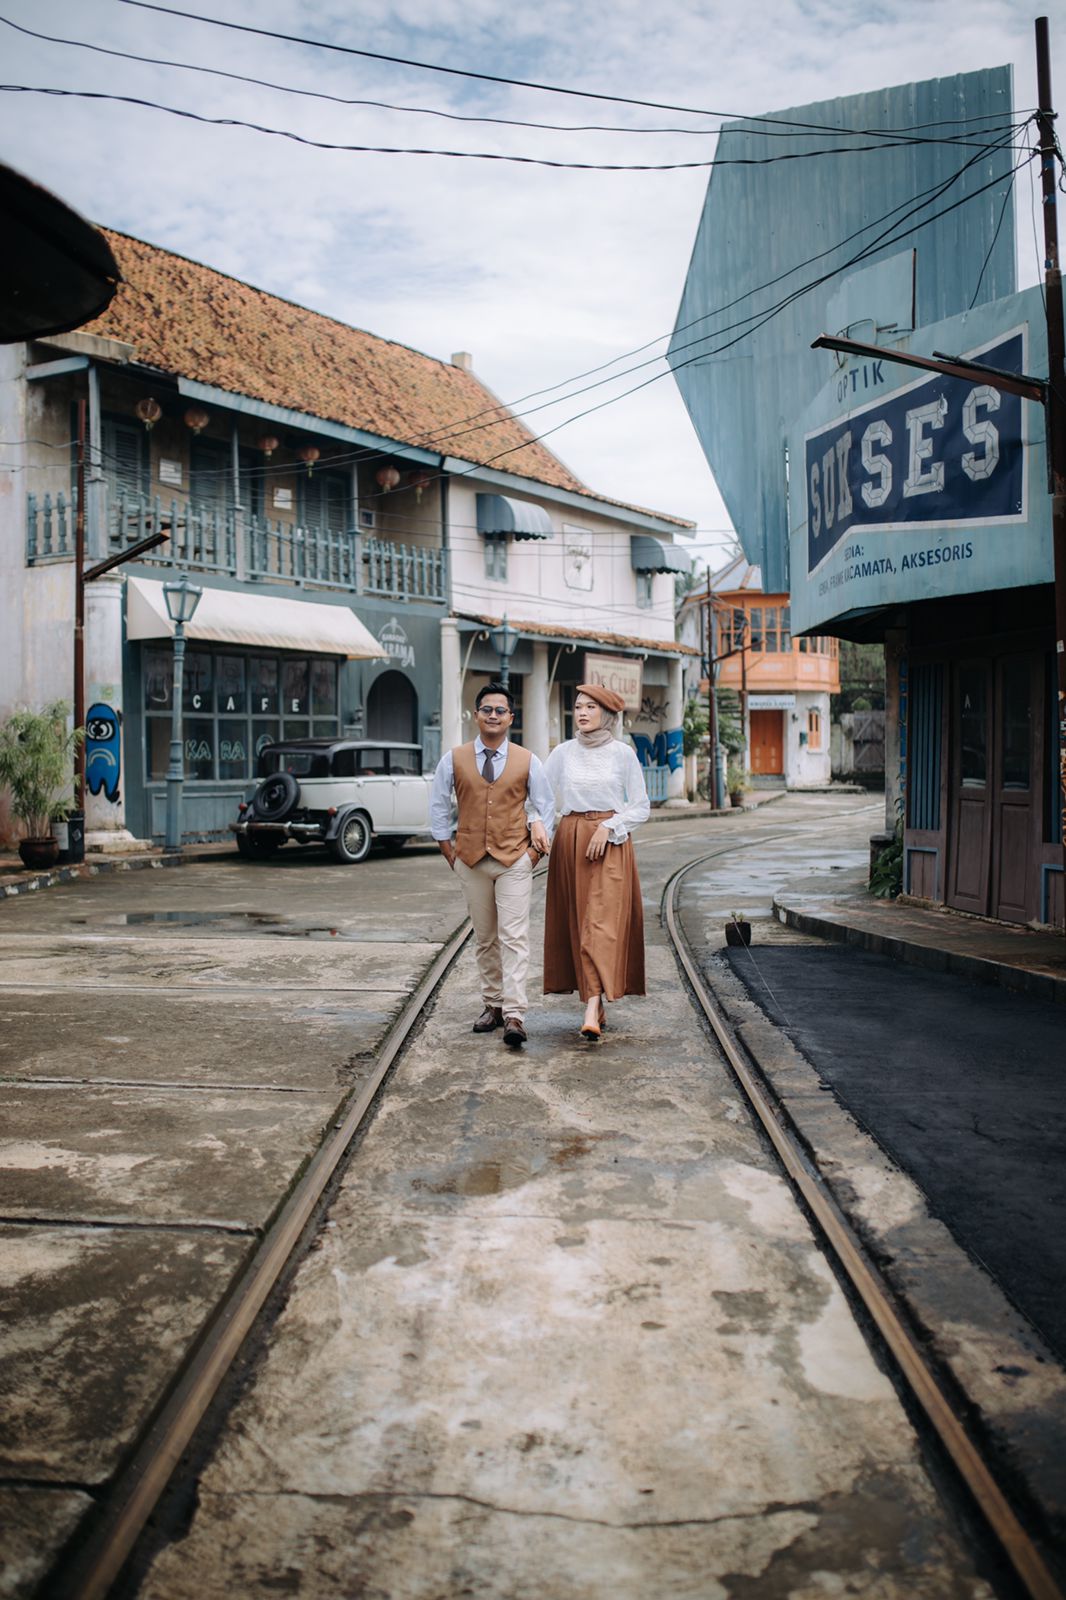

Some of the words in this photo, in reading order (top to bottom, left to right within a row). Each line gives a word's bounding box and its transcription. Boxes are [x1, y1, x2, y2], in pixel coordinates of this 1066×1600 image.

[837, 359, 885, 403] OPTIK
[810, 385, 1002, 539] SUKSES
[901, 541, 974, 571] AKSESORIS
[192, 694, 301, 713] CAFE
